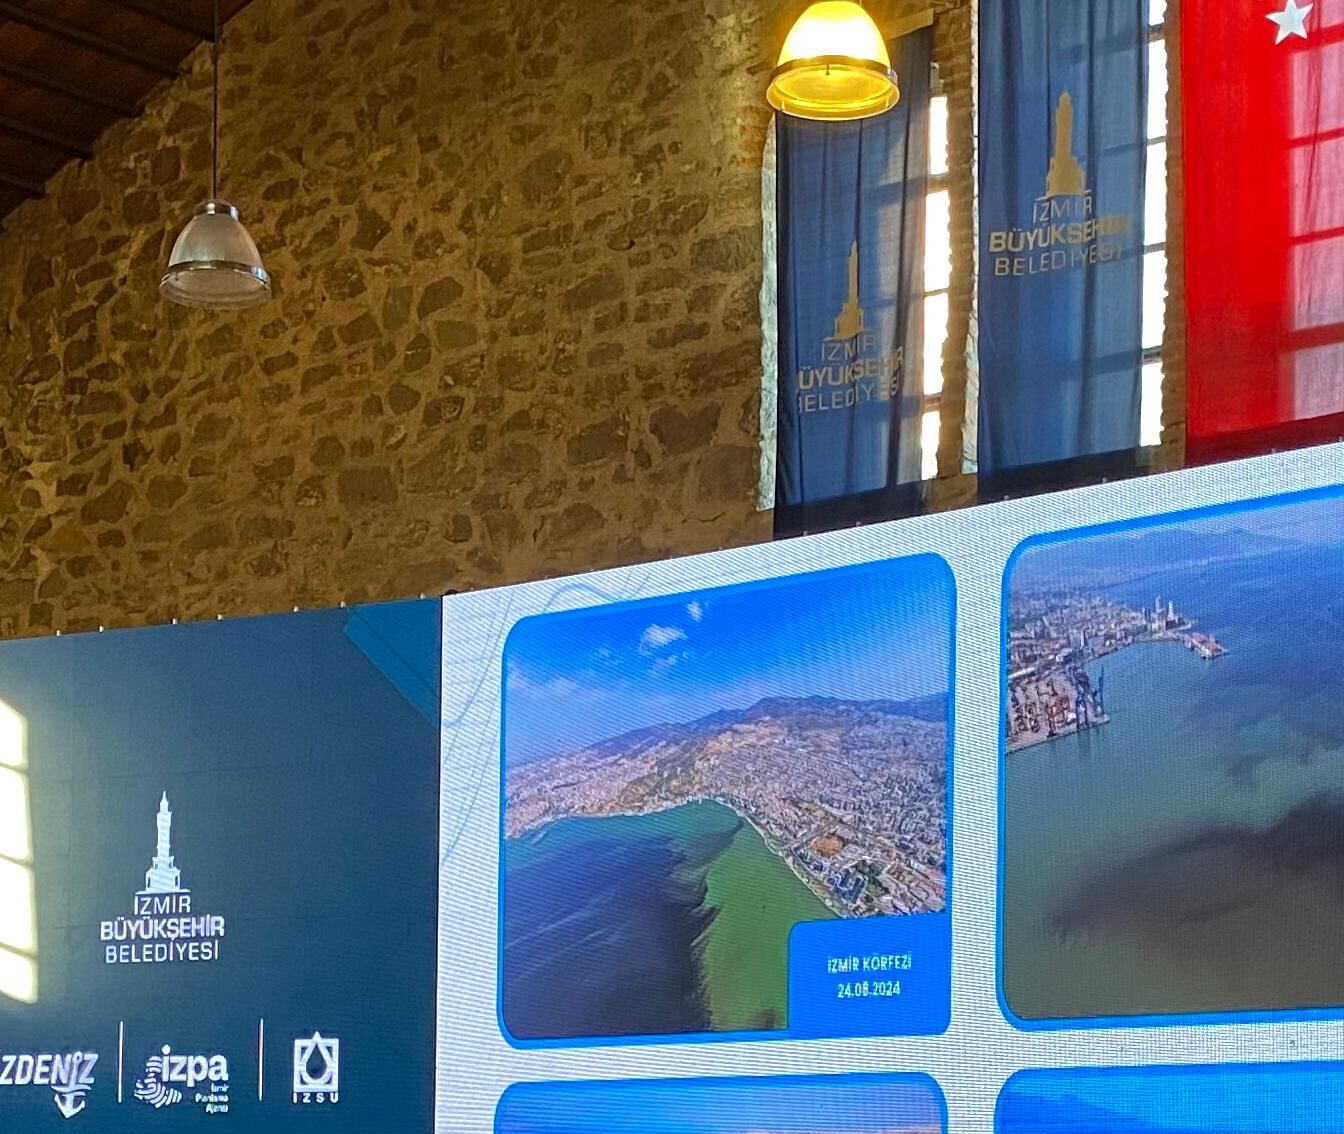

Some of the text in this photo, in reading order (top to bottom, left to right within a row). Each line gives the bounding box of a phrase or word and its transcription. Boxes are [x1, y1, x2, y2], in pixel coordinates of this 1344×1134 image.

[100, 913, 225, 941] BÜYÜKŞEHİR
[105, 939, 219, 964] BELEDİYESİ
[827, 950, 913, 974] İZMİR KÖRFEZİ
[161, 1044, 229, 1088] izpa
